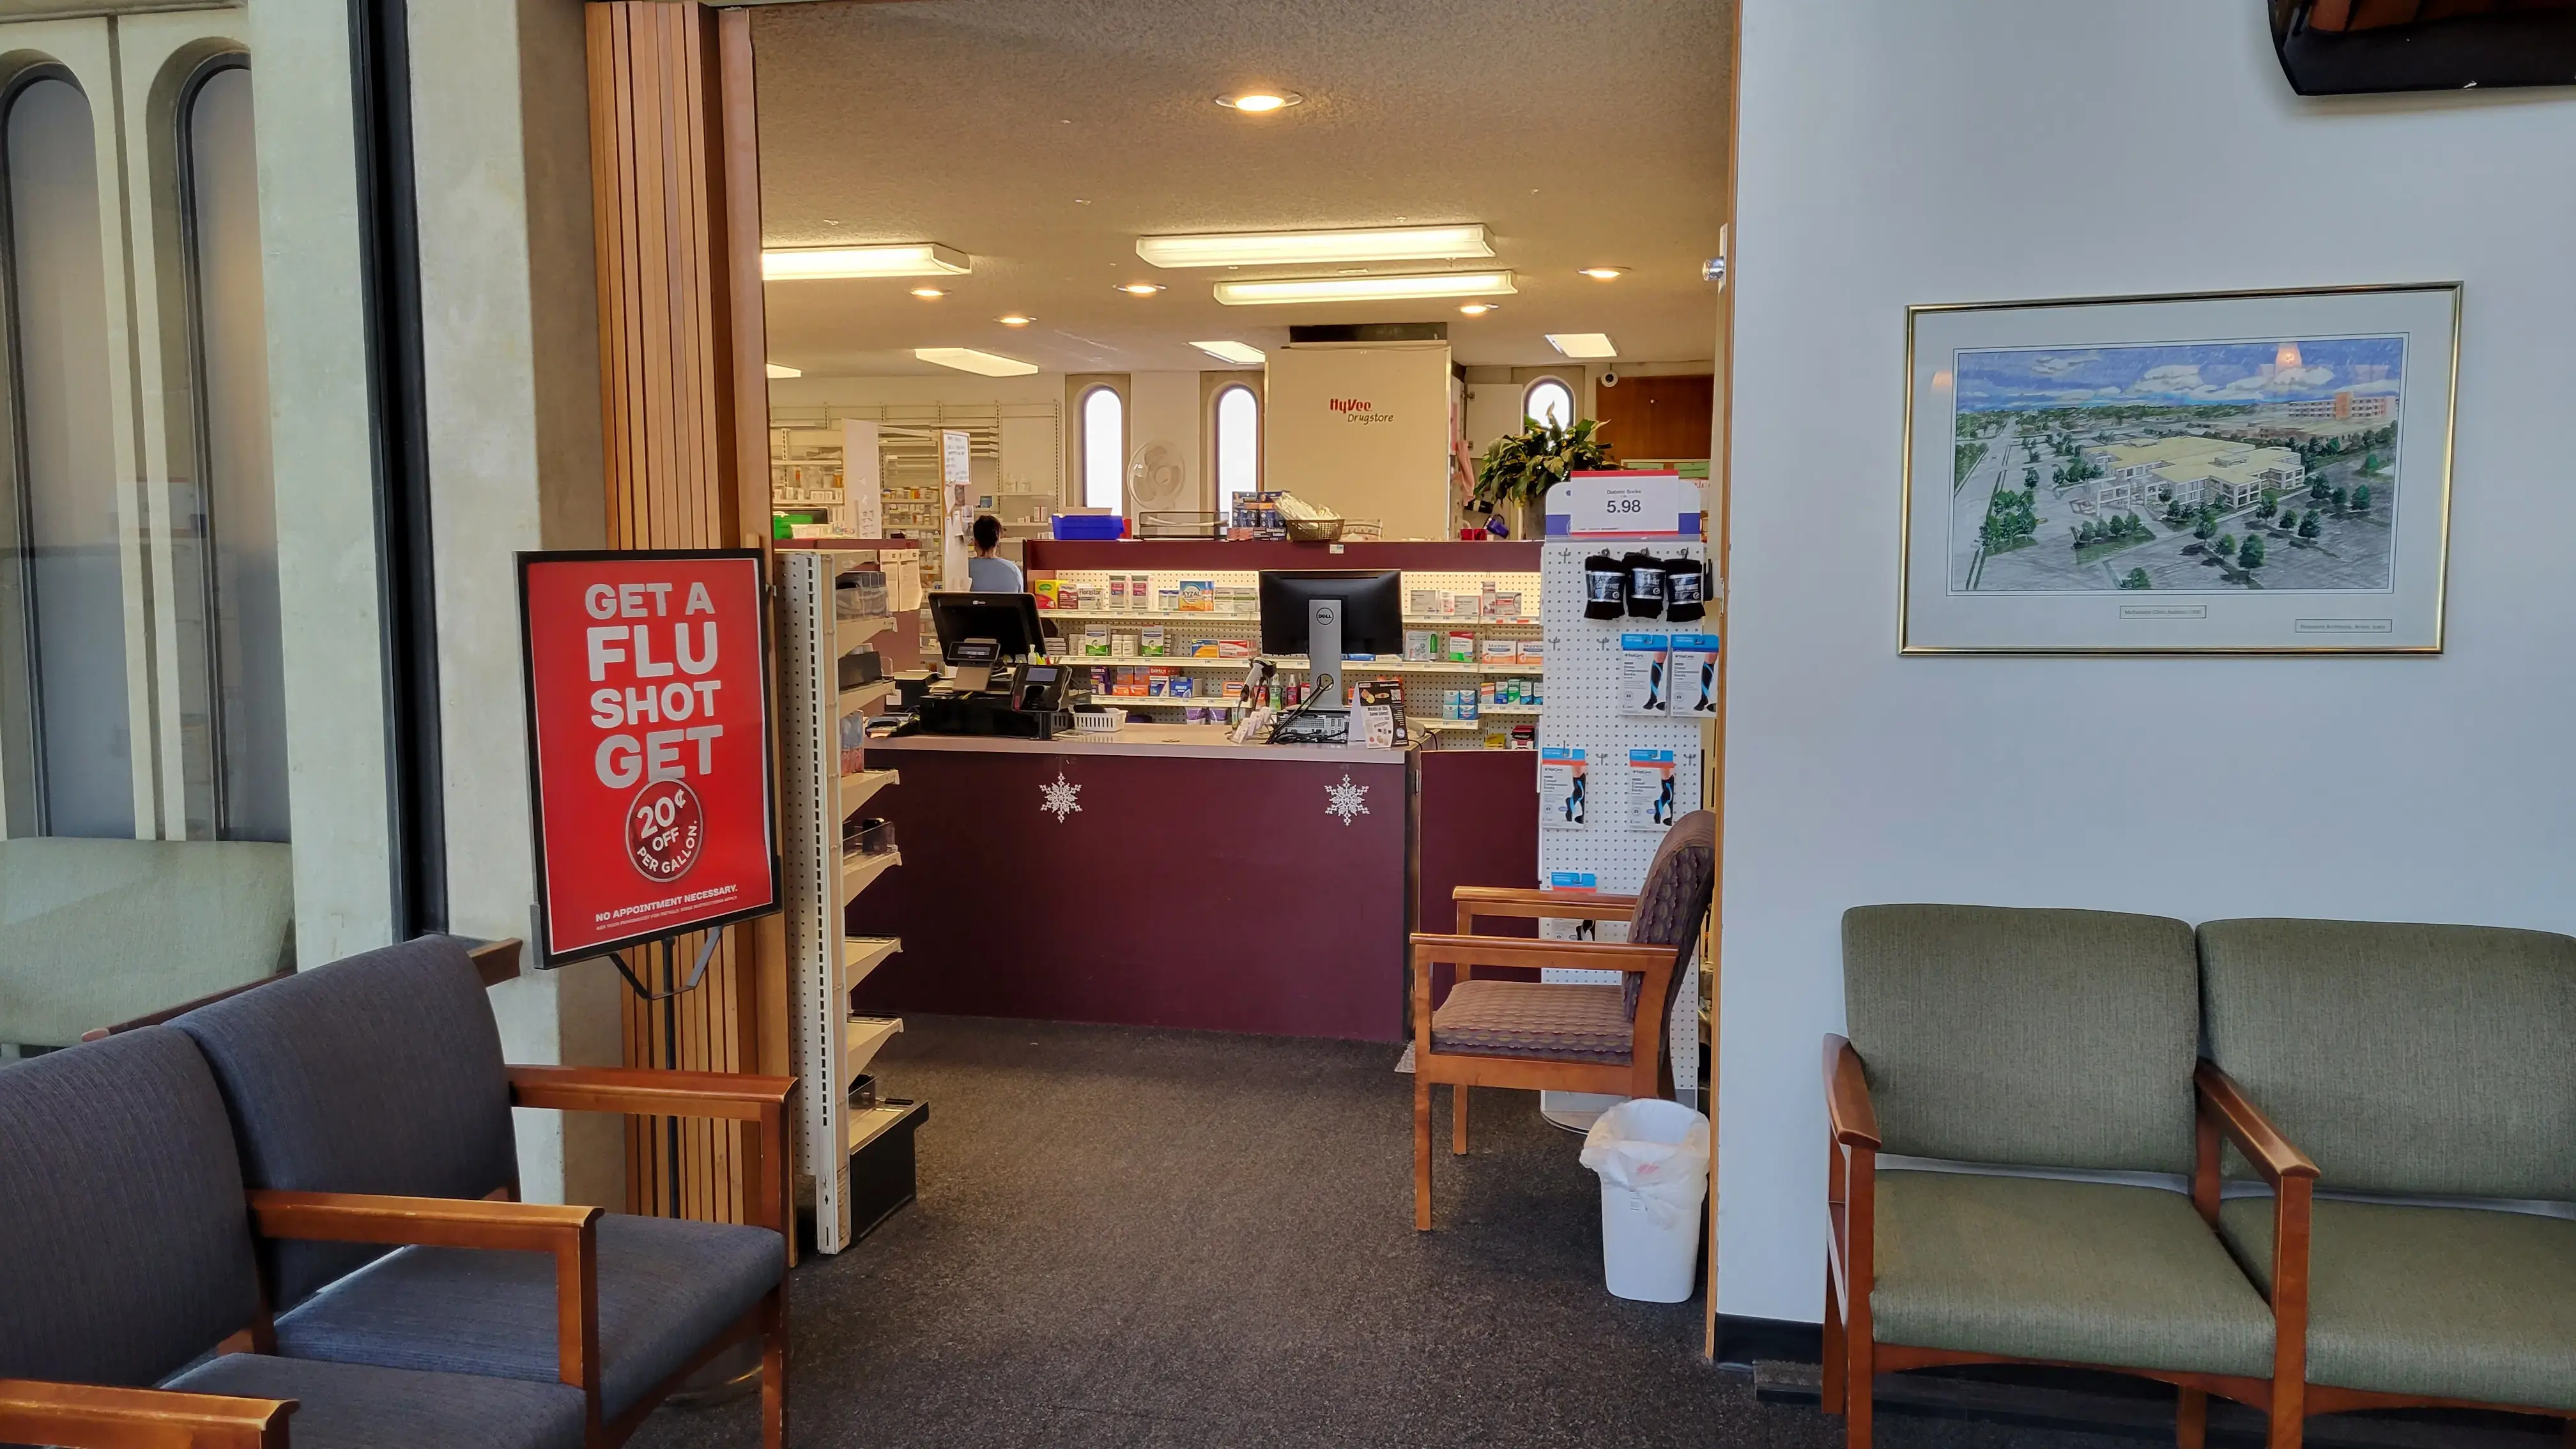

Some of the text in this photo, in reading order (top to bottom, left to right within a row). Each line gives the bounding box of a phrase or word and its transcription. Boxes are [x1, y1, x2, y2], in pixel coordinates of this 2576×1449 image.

[1347, 413, 1393, 425] Drugstore
[1606, 500, 1641, 514] 5.98
[585, 582, 716, 620] GET A
[1078, 588, 1101, 596] Florastor
[586, 621, 719, 682] FLU
[590, 680, 721, 728] SHOT
[595, 724, 723, 789] GET
[637, 788, 686, 839] 20¢
[637, 820, 698, 873] PER GALLON.
[652, 826, 680, 852] OFF
[595, 884, 738, 923] NO APPOINTMENT NECESSARY.
